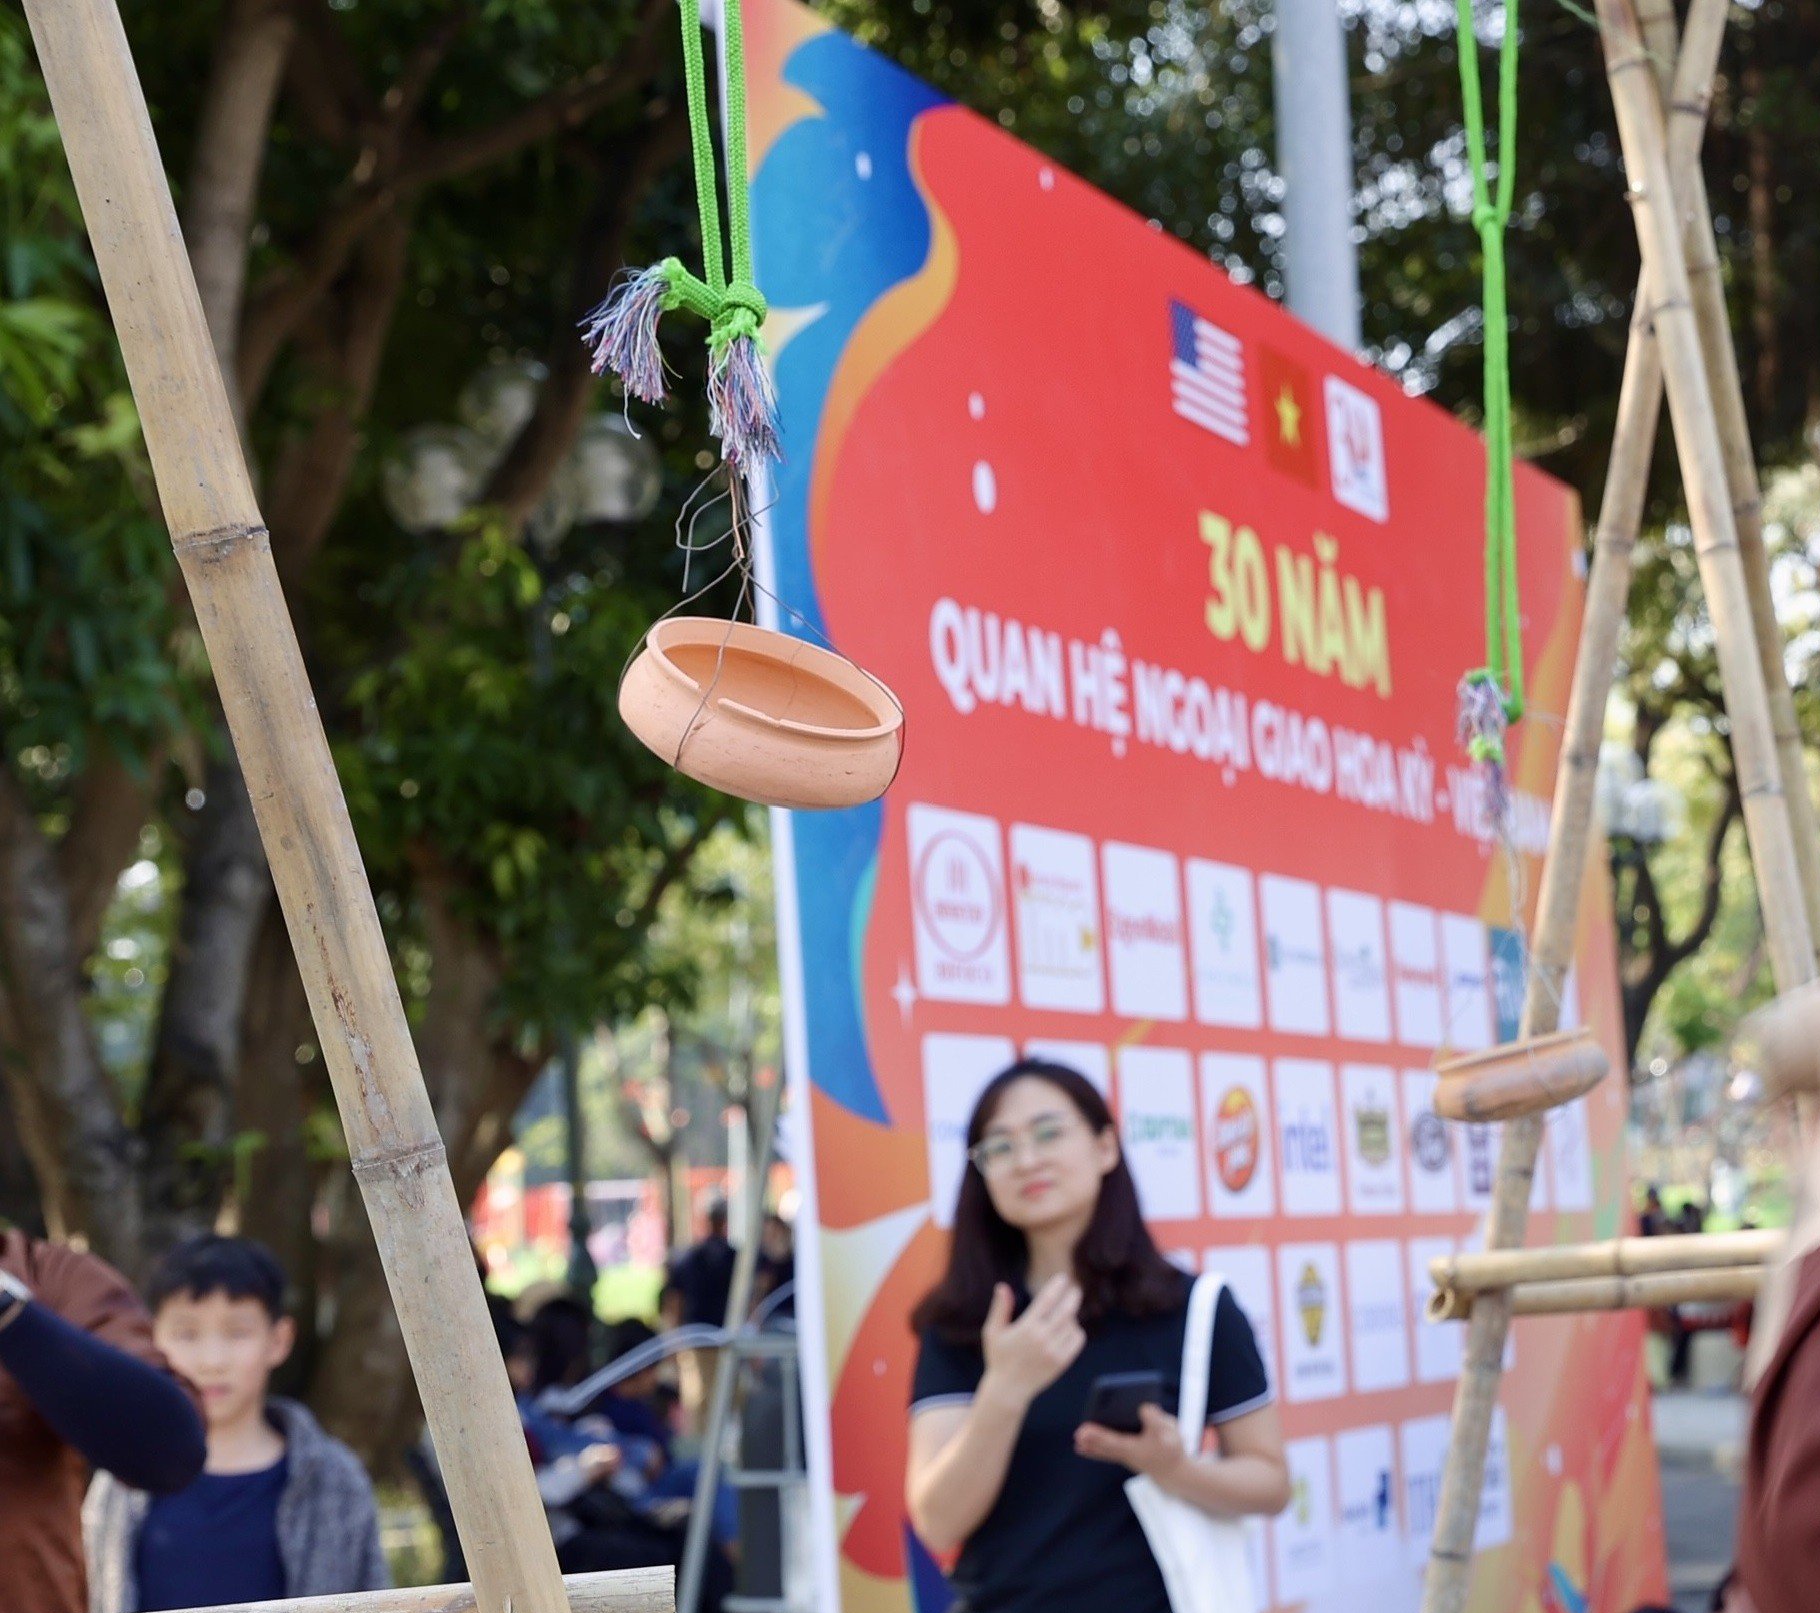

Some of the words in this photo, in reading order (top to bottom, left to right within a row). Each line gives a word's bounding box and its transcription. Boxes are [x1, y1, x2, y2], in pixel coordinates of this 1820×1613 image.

[929, 597, 1066, 716] QUAN
[1068, 627, 1131, 758] HỆ
[1131, 658, 1250, 787] NGOẠI
[1250, 699, 1332, 793] GIAO
[1198, 508, 1272, 654] 30
[1273, 528, 1393, 700] NĂM
